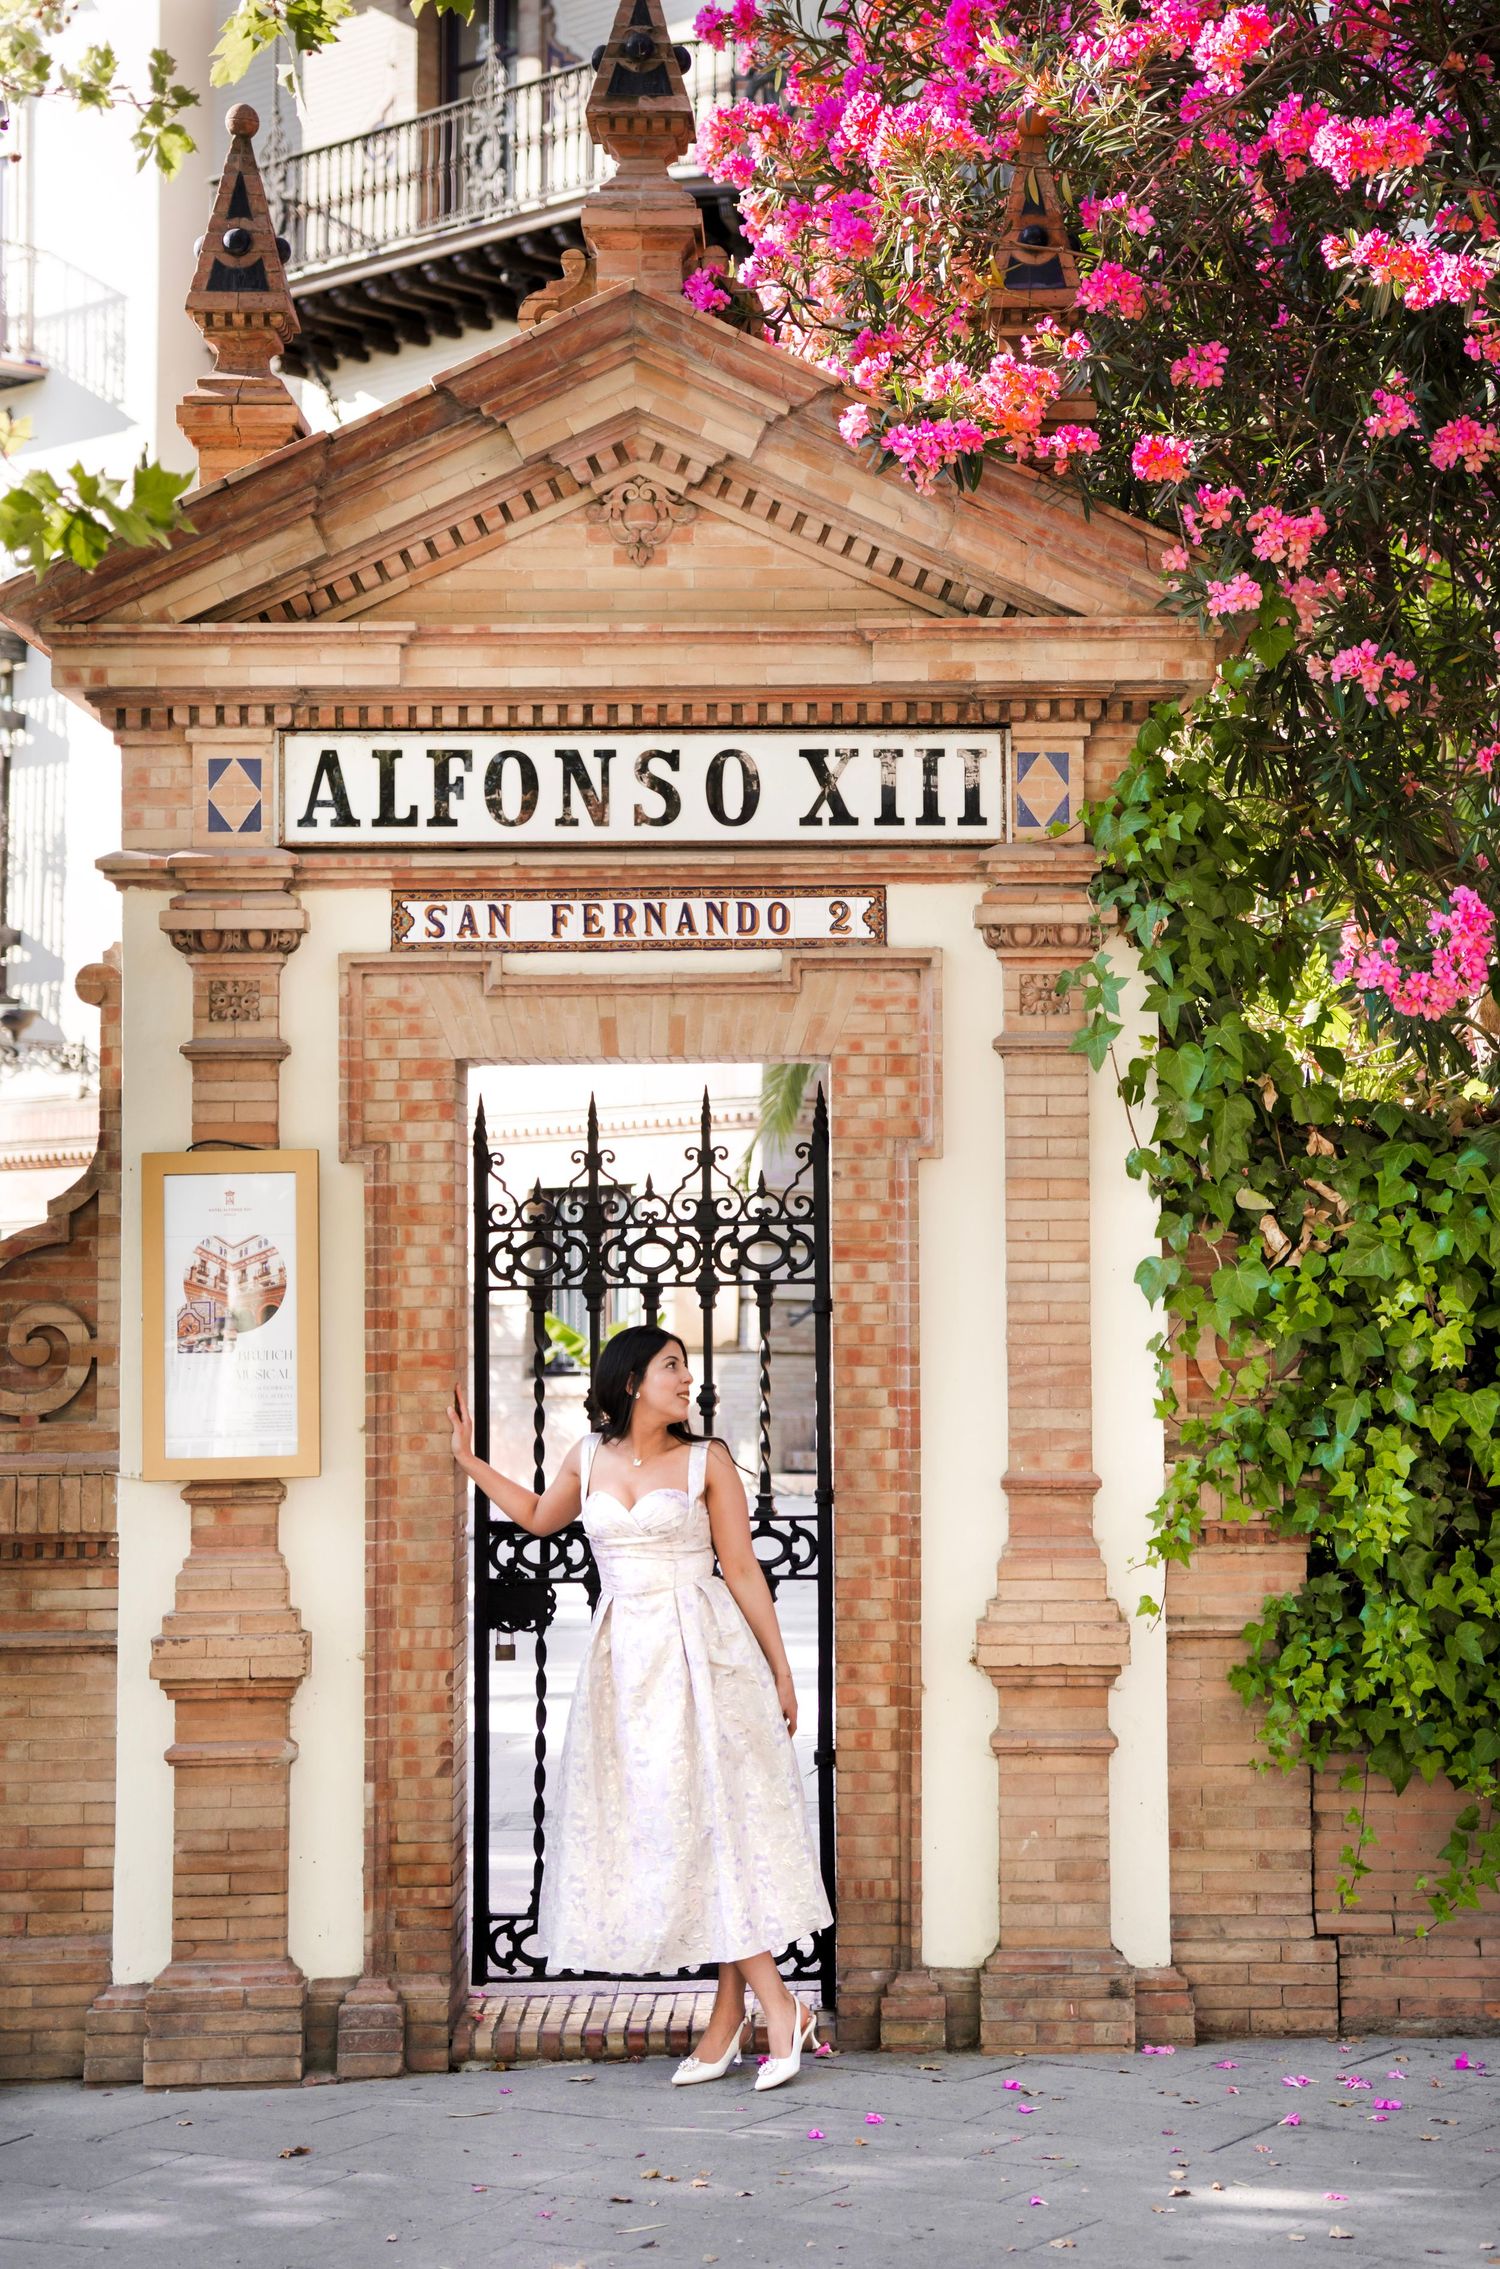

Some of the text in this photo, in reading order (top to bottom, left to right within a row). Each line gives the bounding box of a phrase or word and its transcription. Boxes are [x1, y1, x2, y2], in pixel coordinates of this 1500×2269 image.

[297, 748, 988, 827] ALFONSO XIII
[424, 901, 853, 939] SAN FERNANDO 2
